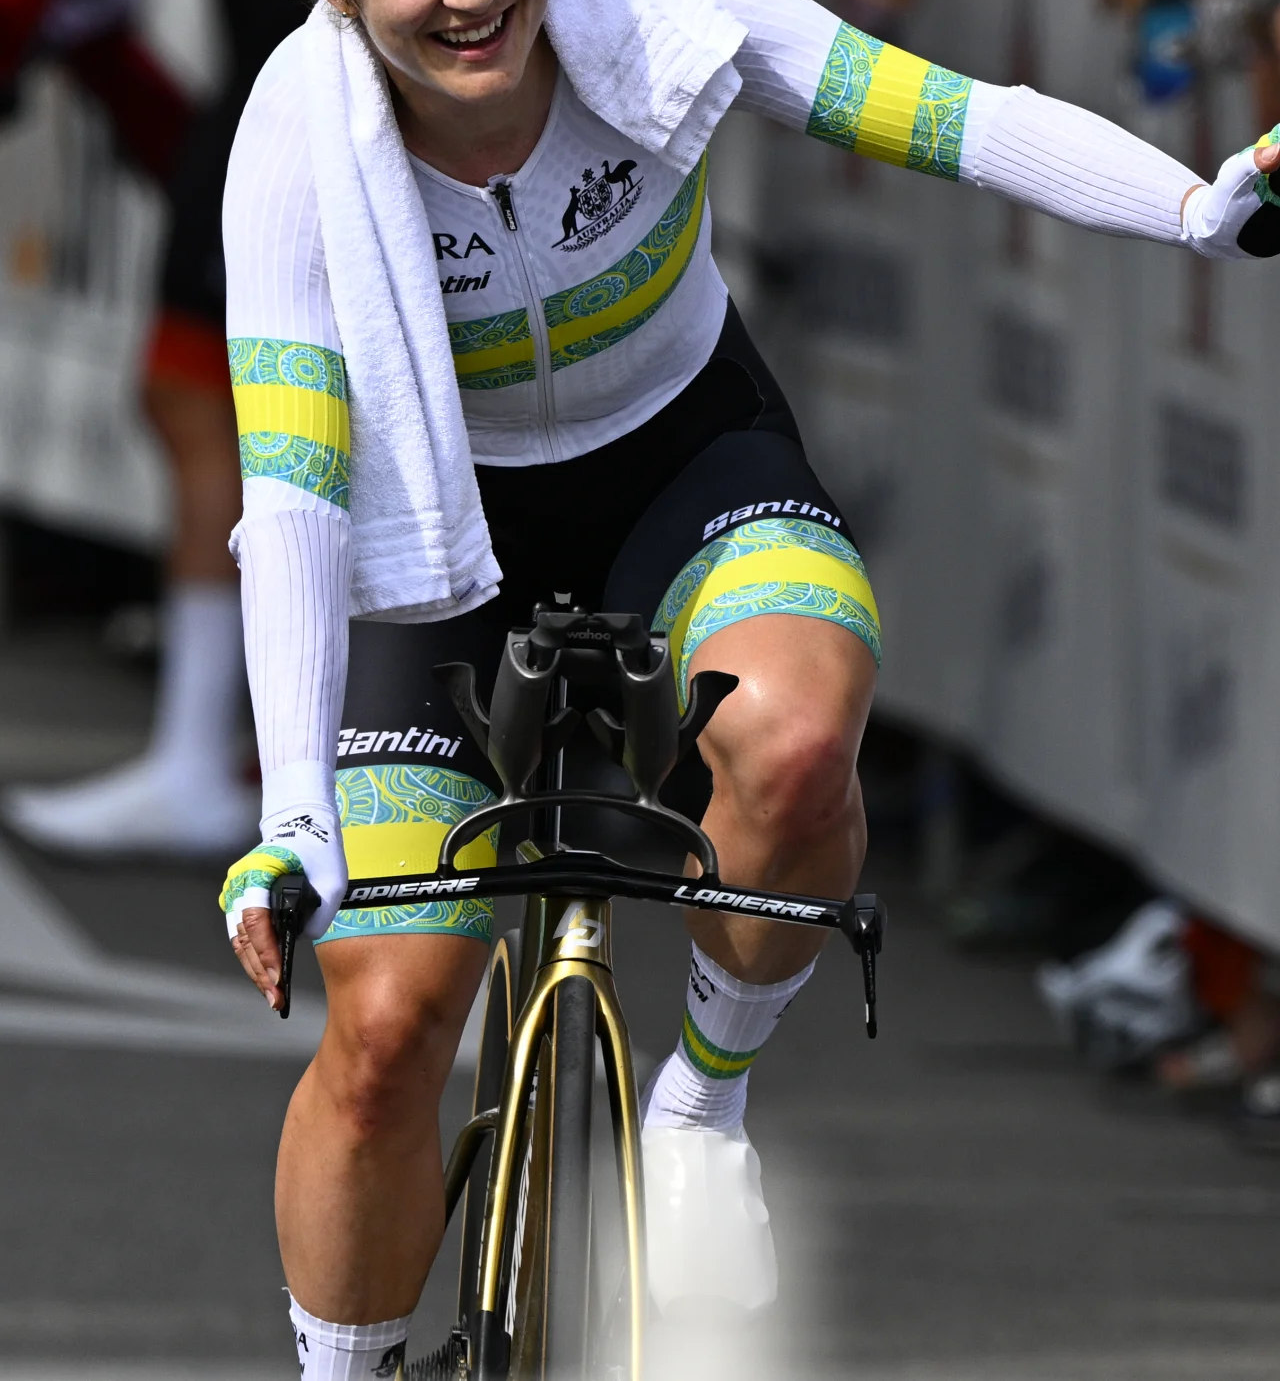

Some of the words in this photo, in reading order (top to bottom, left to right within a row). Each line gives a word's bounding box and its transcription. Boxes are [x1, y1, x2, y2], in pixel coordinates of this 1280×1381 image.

[576, 197, 631, 244] AUSTRALIA
[702, 499, 841, 541] Santini
[566, 627, 612, 641] wahoo
[336, 726, 463, 758] Santini
[342, 877, 481, 902] APIERRE
[673, 885, 827, 919] LAPIERRE
